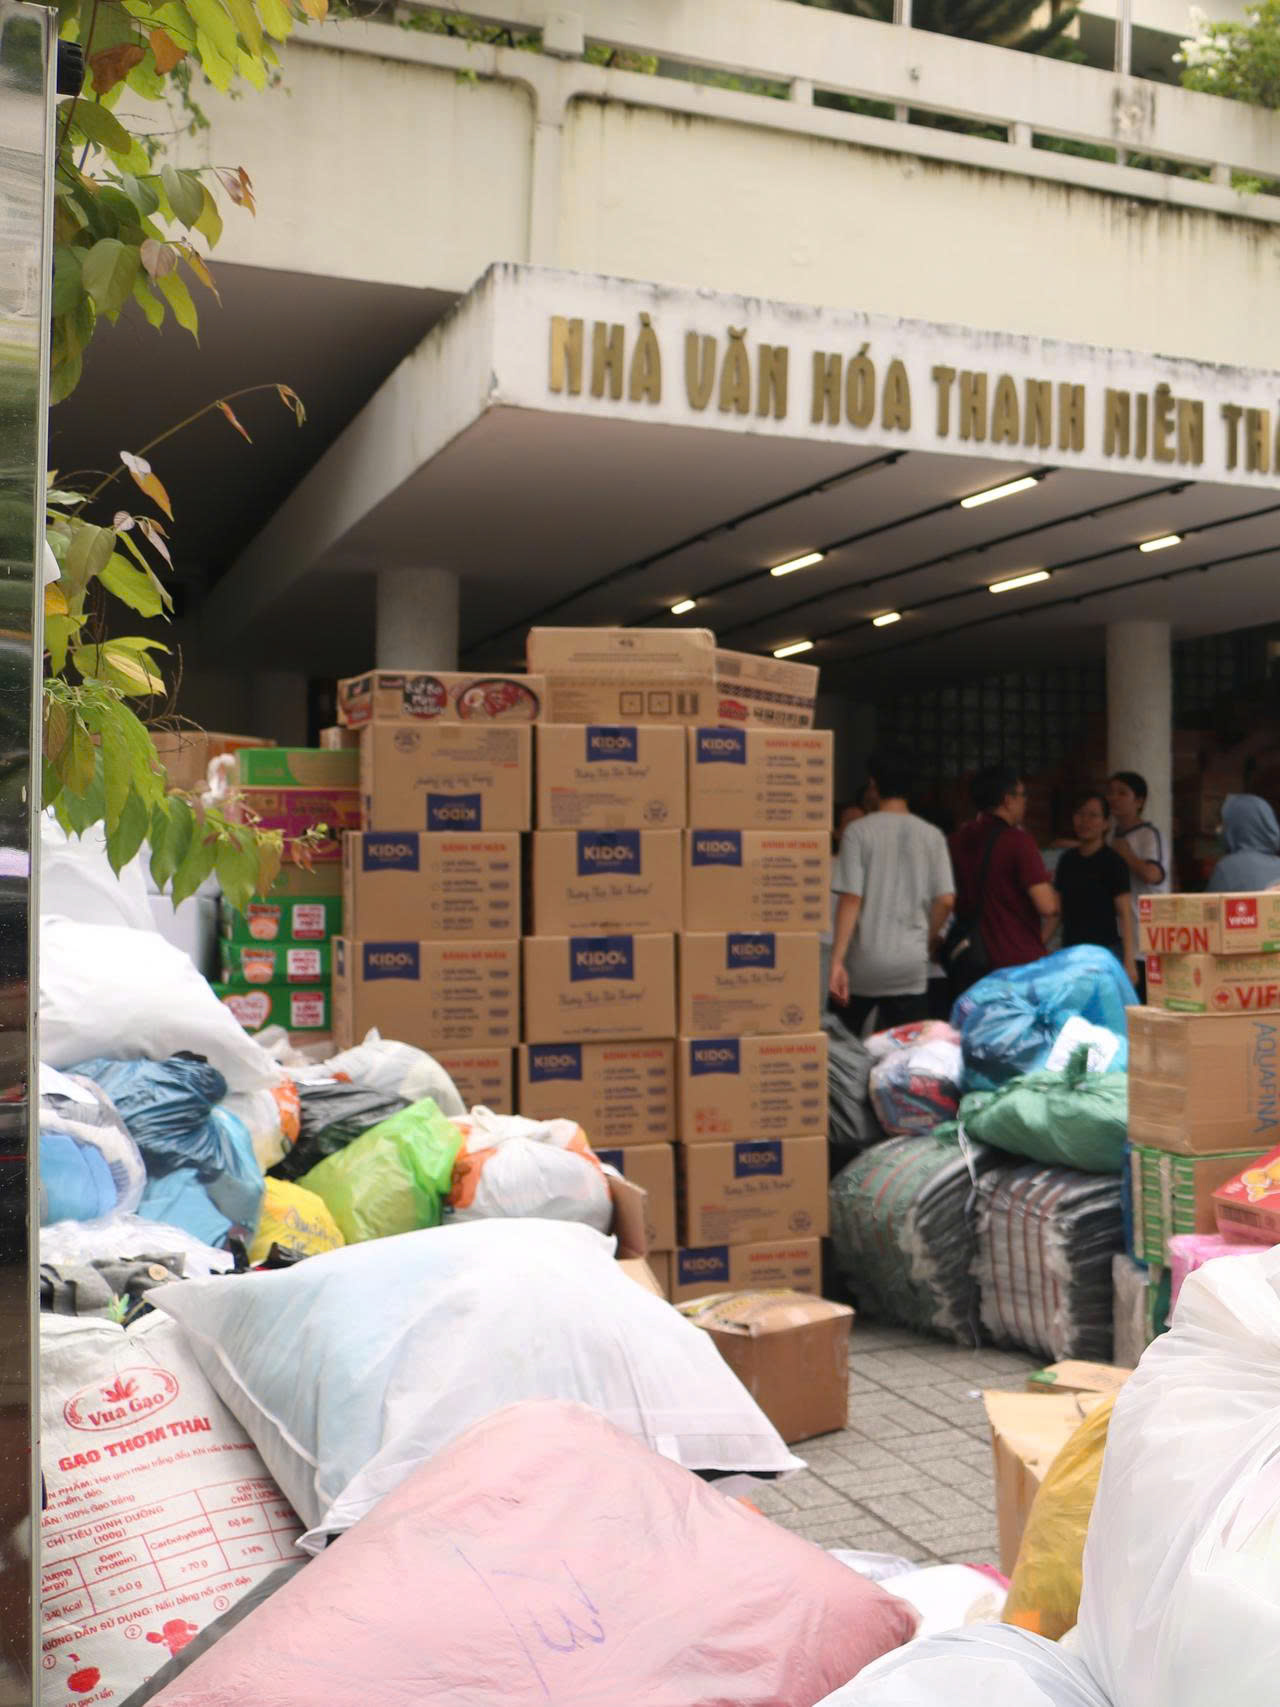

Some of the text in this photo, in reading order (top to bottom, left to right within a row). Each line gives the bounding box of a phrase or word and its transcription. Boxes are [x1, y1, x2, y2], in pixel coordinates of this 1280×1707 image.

[548, 310, 662, 404] NHÀ
[683, 325, 789, 419] VĂN
[811, 341, 911, 432] HÓA
[931, 364, 1085, 451] THANH
[1103, 381, 1204, 466] NIÊN
[1147, 927, 1209, 953] VIFON
[88, 1393, 165, 1427] Vua Gạo
[58, 1449, 102, 1473] GẠO
[104, 1426, 167, 1459] THƠM
[64, 1508, 90, 1521] 100%
[150, 1526, 213, 1550] Carbohydrate
